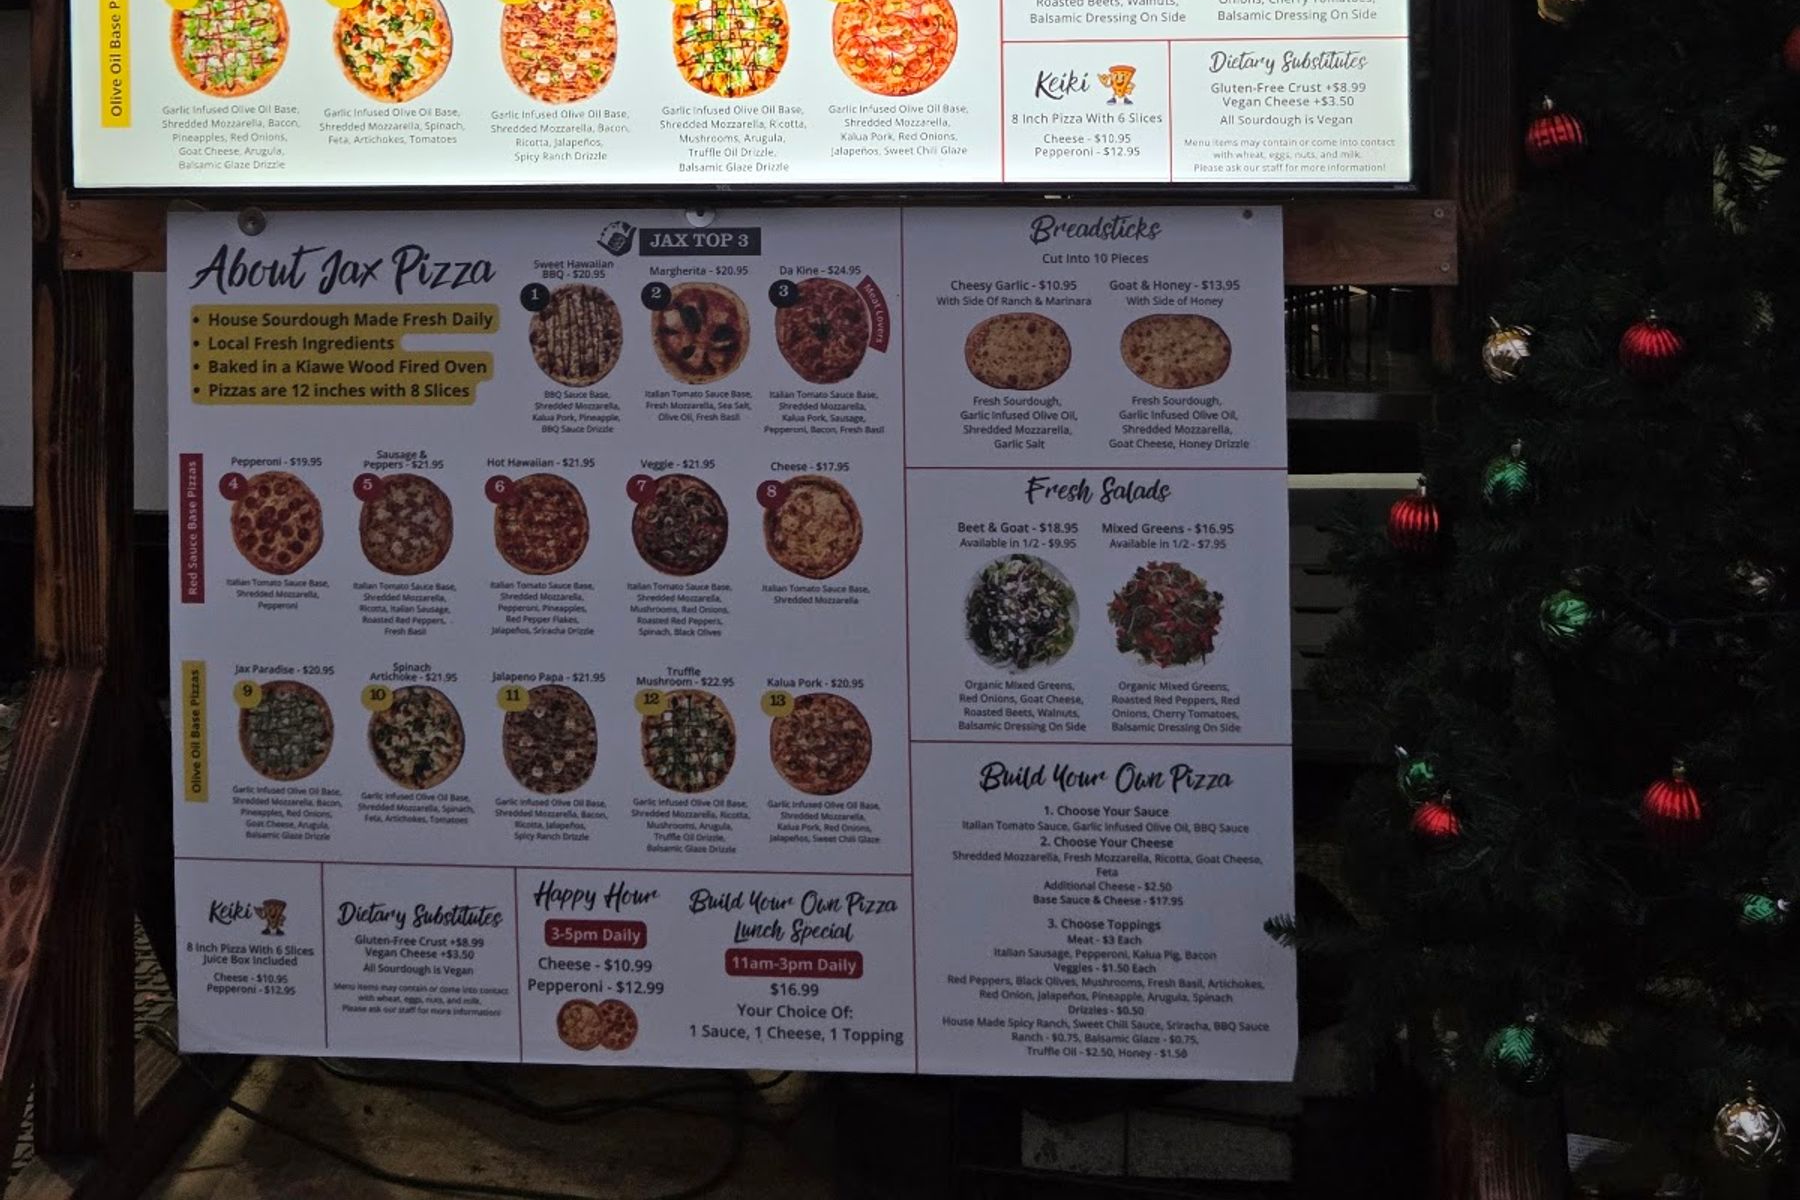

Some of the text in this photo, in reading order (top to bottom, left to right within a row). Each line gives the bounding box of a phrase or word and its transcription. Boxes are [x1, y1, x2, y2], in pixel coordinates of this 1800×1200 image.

[109, 14, 121, 49] Base
[110, 55, 121, 75] Oil
[1209, 50, 1368, 74] Dietary Substitutes
[1035, 70, 1090, 100] Keiki
[1210, 82, 1366, 94] Gluten-Free Crust +$8.99
[111, 78, 122, 117] Olive
[1222, 96, 1354, 110] Vegan Cheese +$3.50
[1011, 112, 1163, 124] 8 Inch Pizza With 6 Slices
[1220, 114, 1353, 128] All Sourdough is Vegan
[650, 232, 749, 248] JAX TOP 3
[1029, 214, 1163, 245] Breadsticks
[1042, 253, 1149, 264] Cut Into 10 Pieces
[188, 244, 496, 295] About Jax Pizza
[208, 335, 395, 354] Local Fresh Ingredients
[1025, 476, 1171, 505] Fresh Salads
[979, 762, 1233, 793] Build Your Own Pizza
[1056, 805, 1101, 817] Choose
[1102, 806, 1131, 817] Your
[1134, 805, 1169, 818] Sauce
[533, 880, 660, 913] Happy Hour
[689, 888, 898, 917] Build Your Own Pizza
[337, 901, 503, 929] Dietary Substitutes
[552, 927, 641, 946] 3-5pm Daily
[734, 919, 854, 945] Lunch Special
[732, 956, 856, 975] 11am-3pm Daily
[770, 983, 819, 997] $16.99
[737, 1003, 853, 1019] Your Choice Of:
[690, 1024, 696, 1037] 1
[754, 1026, 761, 1039] 1
[830, 1027, 837, 1041] 1
[842, 1028, 904, 1047] Topping
